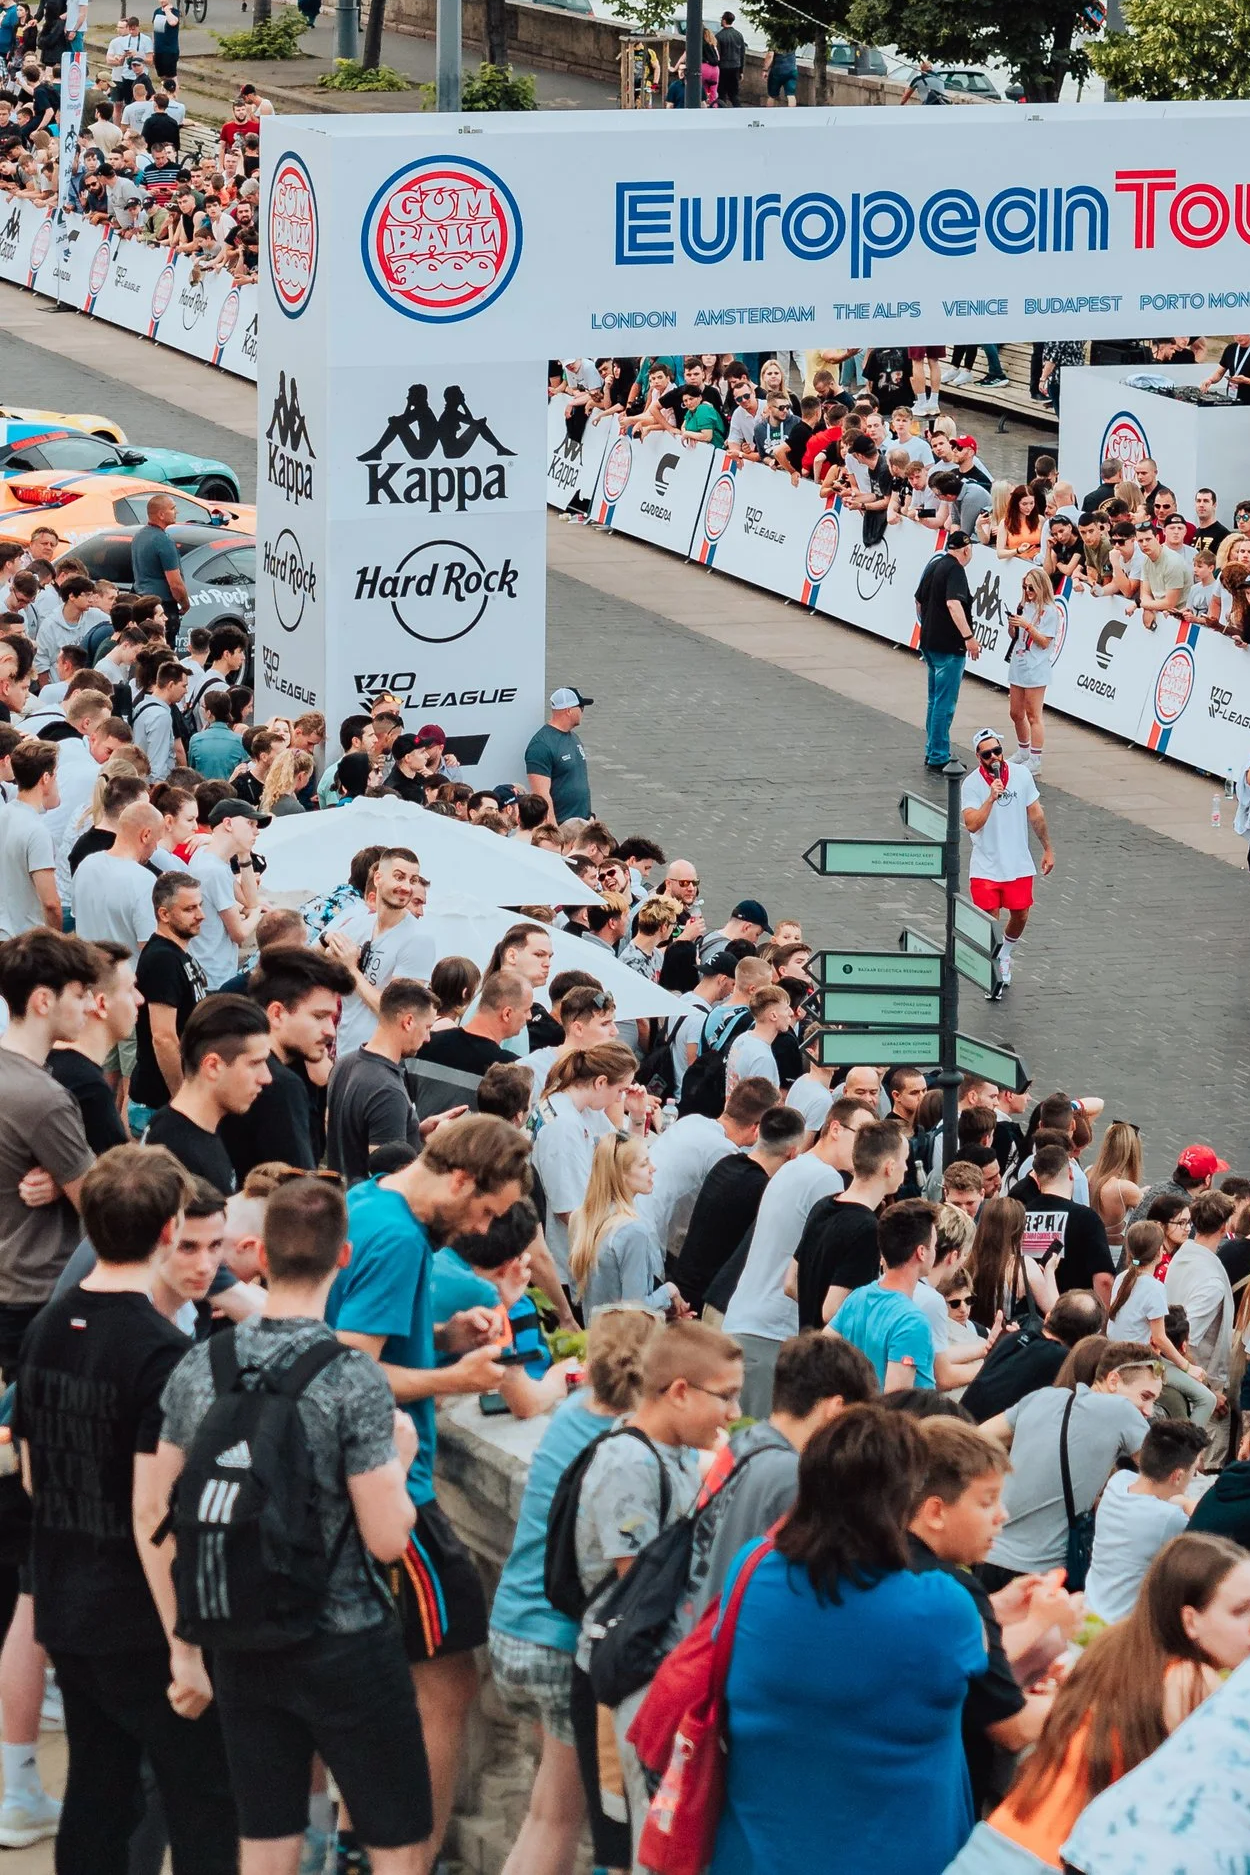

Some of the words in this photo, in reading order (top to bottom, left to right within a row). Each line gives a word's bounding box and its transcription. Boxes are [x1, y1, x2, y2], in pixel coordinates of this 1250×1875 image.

[275, 182, 309, 220] GUM
[388, 186, 500, 223] GUM
[273, 213, 309, 254] BALL
[382, 220, 500, 257] BALL
[614, 179, 1109, 279] European
[274, 249, 309, 290] 3000
[388, 254, 498, 293] 3000
[591, 310, 677, 330] LONDON
[694, 306, 816, 326] AMSTERDAM
[833, 302, 871, 320] THE
[872, 301, 921, 319] ALPS
[942, 298, 1009, 317] VENICE
[1024, 295, 1123, 315] BUDAPEST
[1139, 292, 1206, 312] PORTO
[1107, 432, 1146, 466] GUM
[266, 440, 314, 506] Kappa
[365, 460, 510, 513] Kappa
[547, 454, 579, 489] Kappa
[263, 539, 288, 578] Hard
[288, 555, 317, 603] Rock
[355, 562, 440, 601] Hard
[442, 558, 520, 603] Rock
[849, 543, 876, 571] Hard
[872, 552, 896, 585] Rock
[972, 619, 999, 654] appa
[353, 671, 417, 694] V10
[1076, 673, 1117, 701] CARRERA
[1209, 684, 1233, 707] V10
